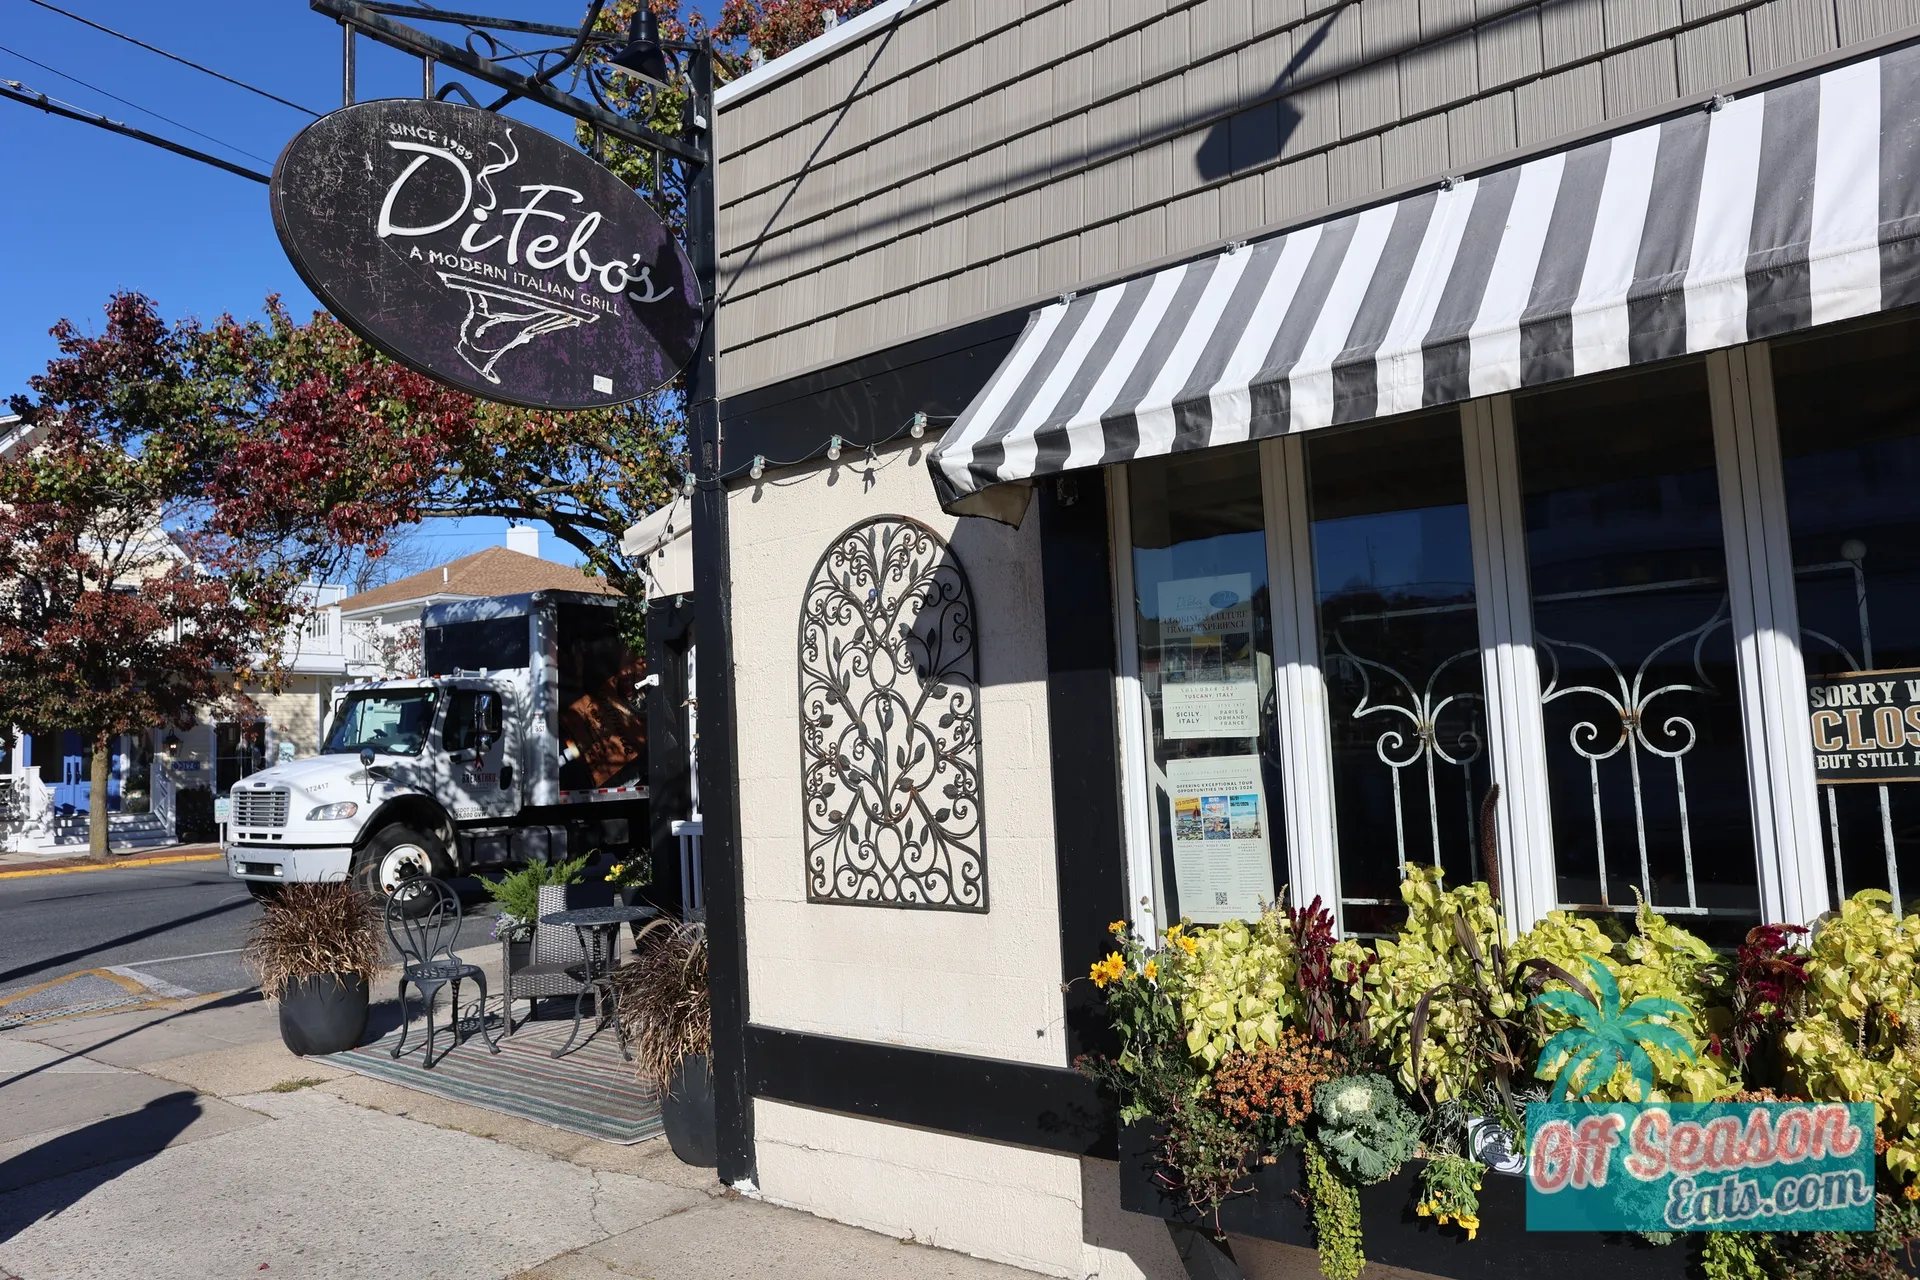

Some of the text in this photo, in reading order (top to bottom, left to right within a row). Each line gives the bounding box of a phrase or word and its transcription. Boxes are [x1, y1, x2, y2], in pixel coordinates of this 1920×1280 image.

[389, 122, 473, 160] SINCE 1989
[409, 245, 621, 317] A MODERN ITALIAN GRILL
[1211, 610, 1248, 620] CULTURE
[1810, 681, 1897, 708] SORRY
[1816, 754, 1852, 770] BUT
[1857, 752, 1909, 768] STILL
